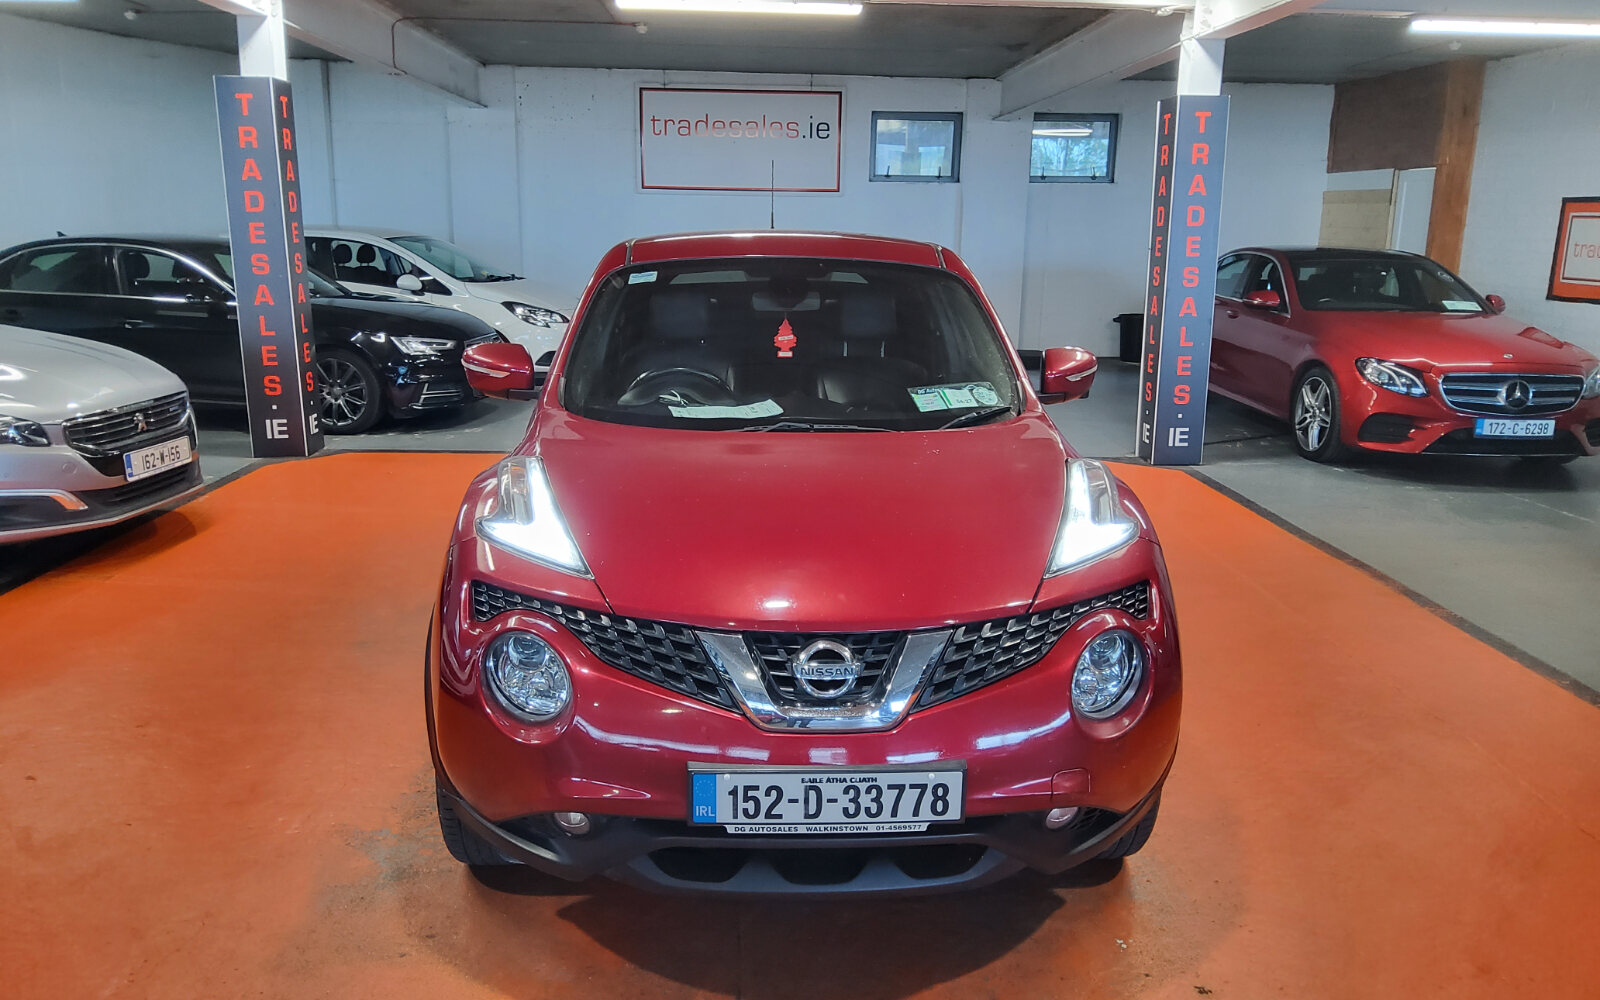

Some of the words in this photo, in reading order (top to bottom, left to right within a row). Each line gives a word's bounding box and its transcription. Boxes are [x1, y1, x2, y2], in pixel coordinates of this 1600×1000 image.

[650, 113, 830, 140] tradesales.ie
[1488, 422, 1550, 435] 172-C-6298
[800, 666, 855, 677] NISSAN
[727, 783, 950, 820] 152-D-33778
[695, 805, 716, 817] IRL
